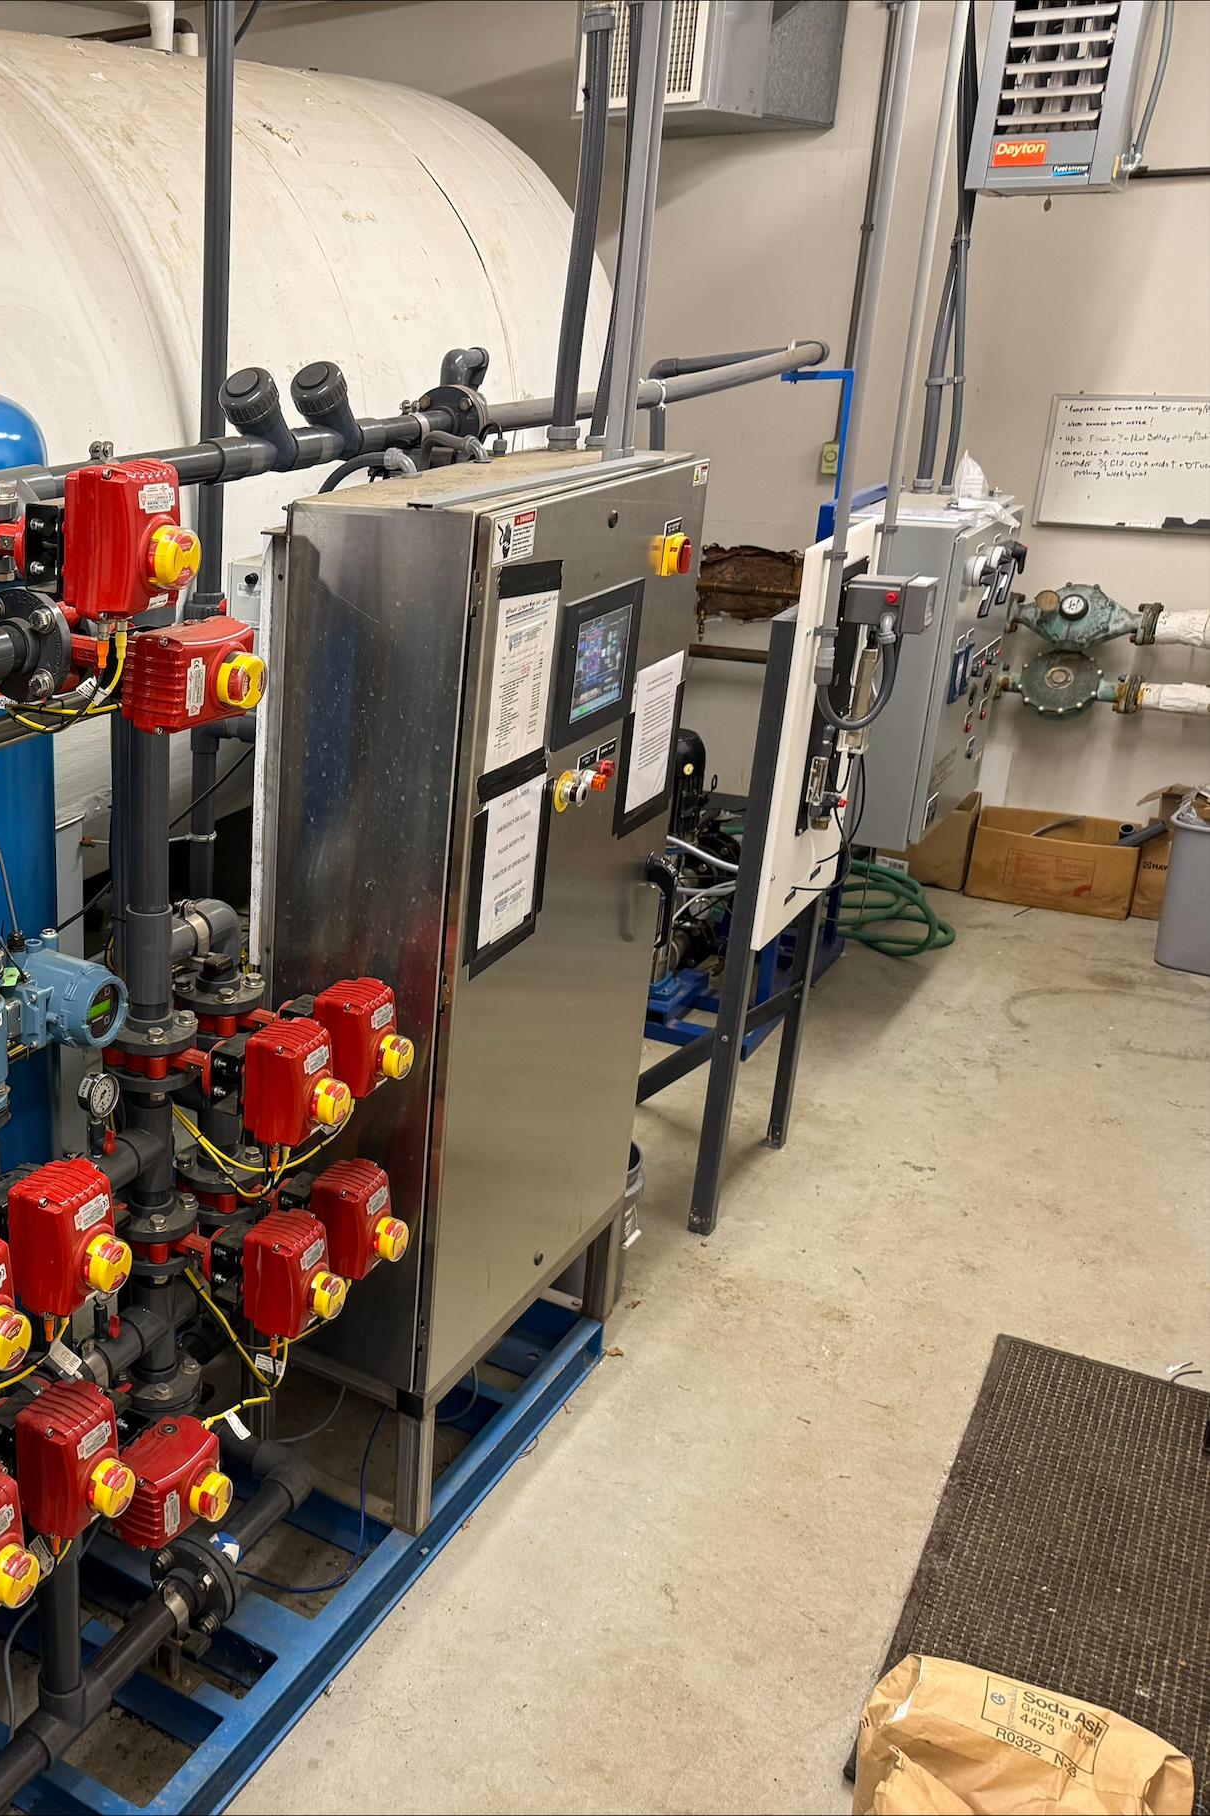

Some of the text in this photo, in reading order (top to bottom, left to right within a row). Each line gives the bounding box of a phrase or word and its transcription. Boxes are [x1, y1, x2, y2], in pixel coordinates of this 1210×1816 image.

[996, 143, 1045, 157] Dayton
[1019, 1713, 1056, 1736] 4473
[1021, 1702, 1055, 1723] Grade
[1059, 1719, 1078, 1734] 100
[1023, 1690, 1070, 1720] Soda
[1074, 1711, 1103, 1738] Ash
[995, 1726, 1043, 1757] R0322
